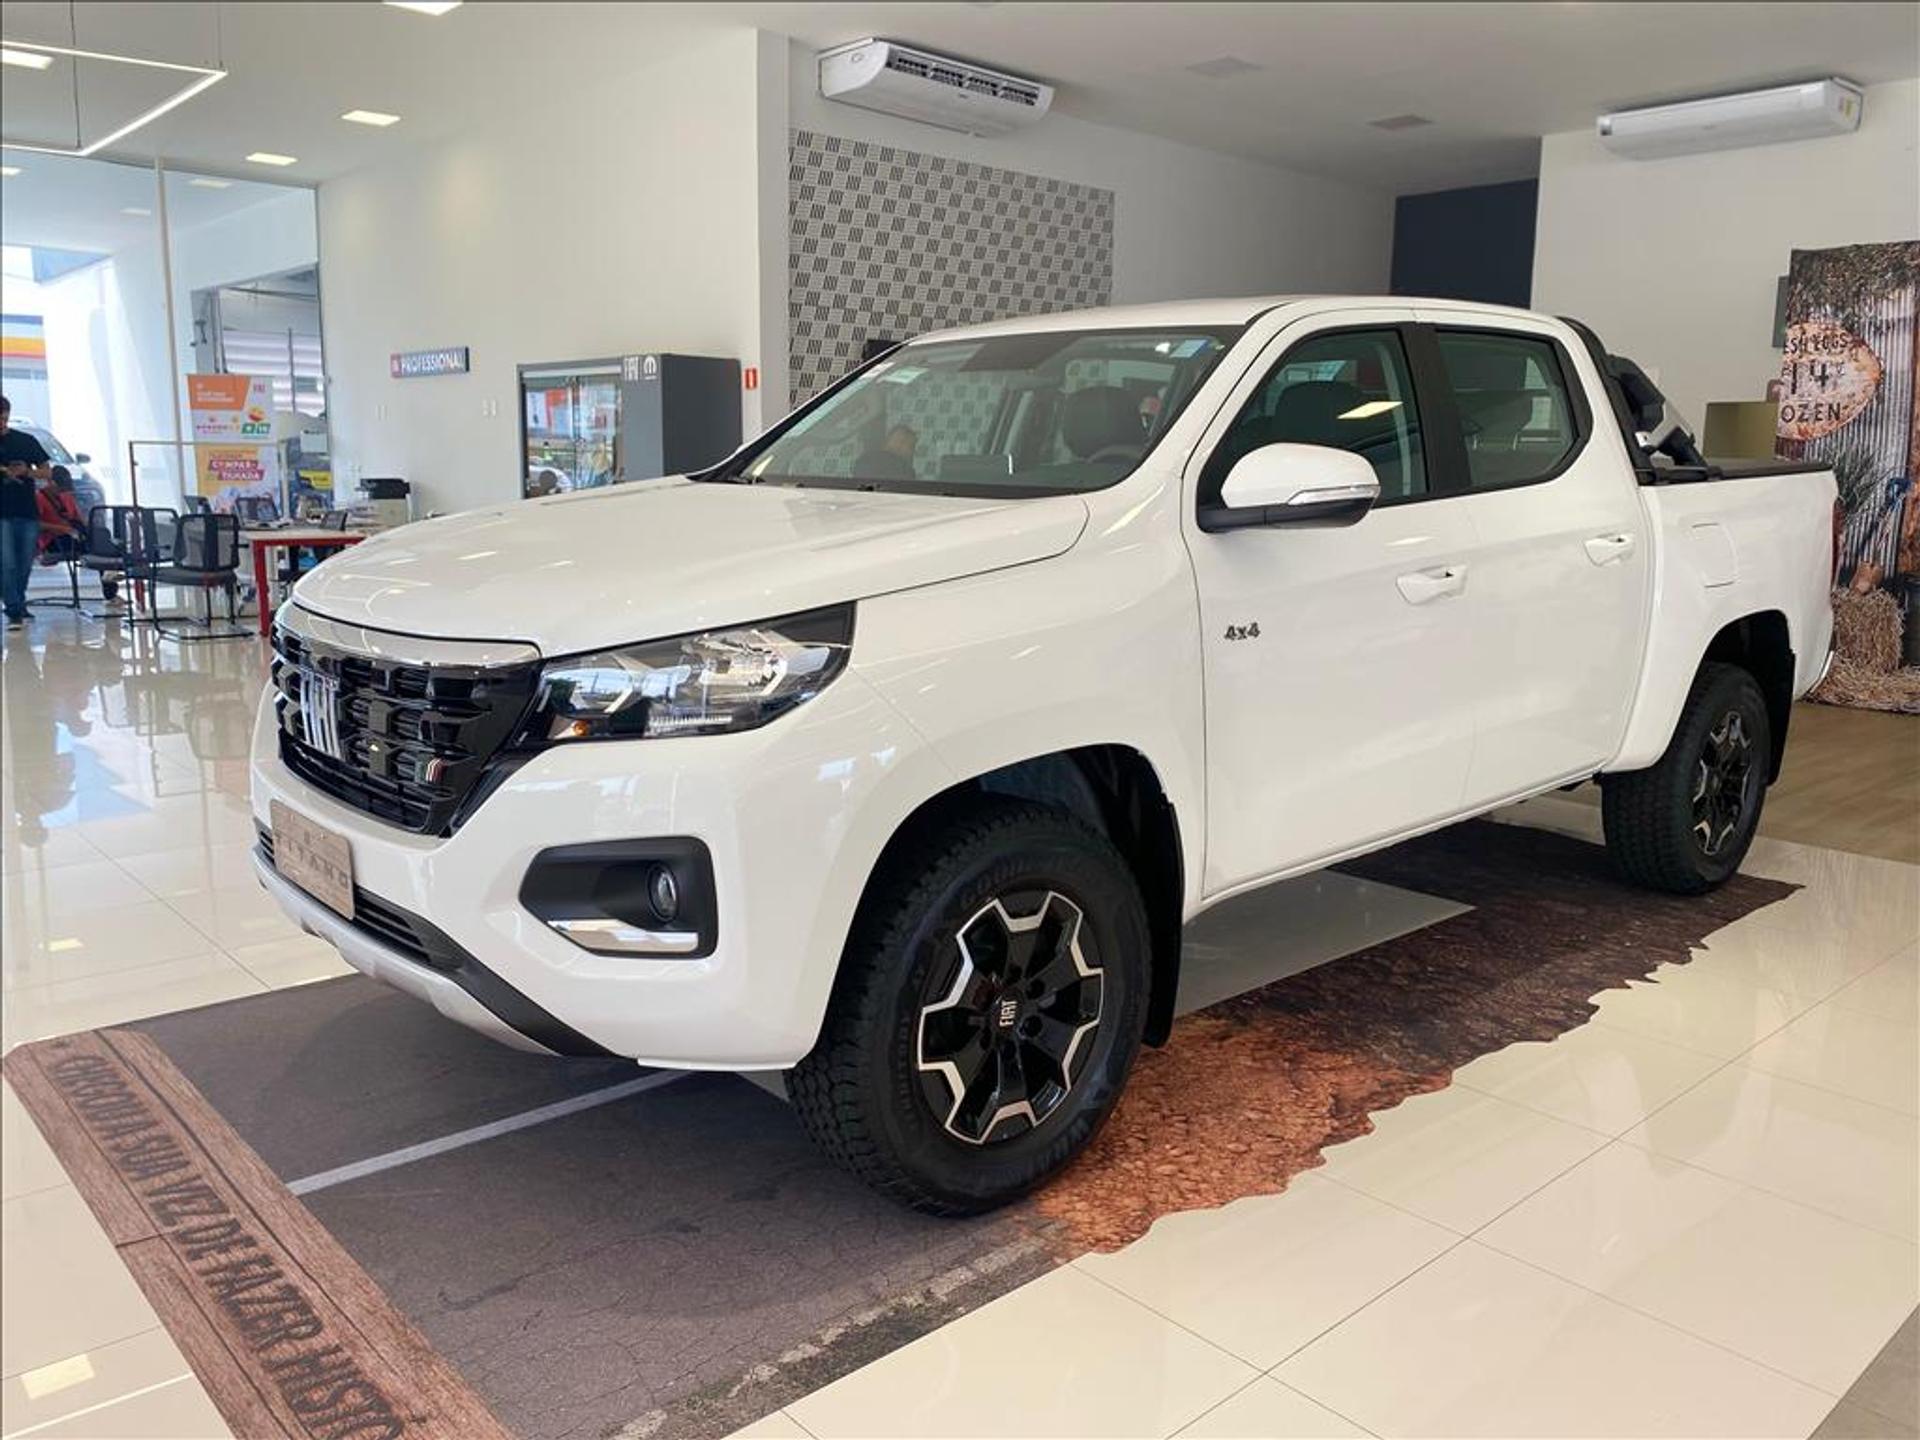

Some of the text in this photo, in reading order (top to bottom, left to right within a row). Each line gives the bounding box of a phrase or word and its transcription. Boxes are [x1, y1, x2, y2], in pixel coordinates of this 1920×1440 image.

[401, 352, 464, 375] PROFESSIONAL
[1224, 622, 1260, 640] 4x4
[1000, 1000, 1018, 1027] FIAT
[112, 1134, 191, 1182] SUA
[145, 1173, 231, 1227] VEZ
[177, 1218, 257, 1261] DE
[198, 1253, 323, 1352] FAZER
